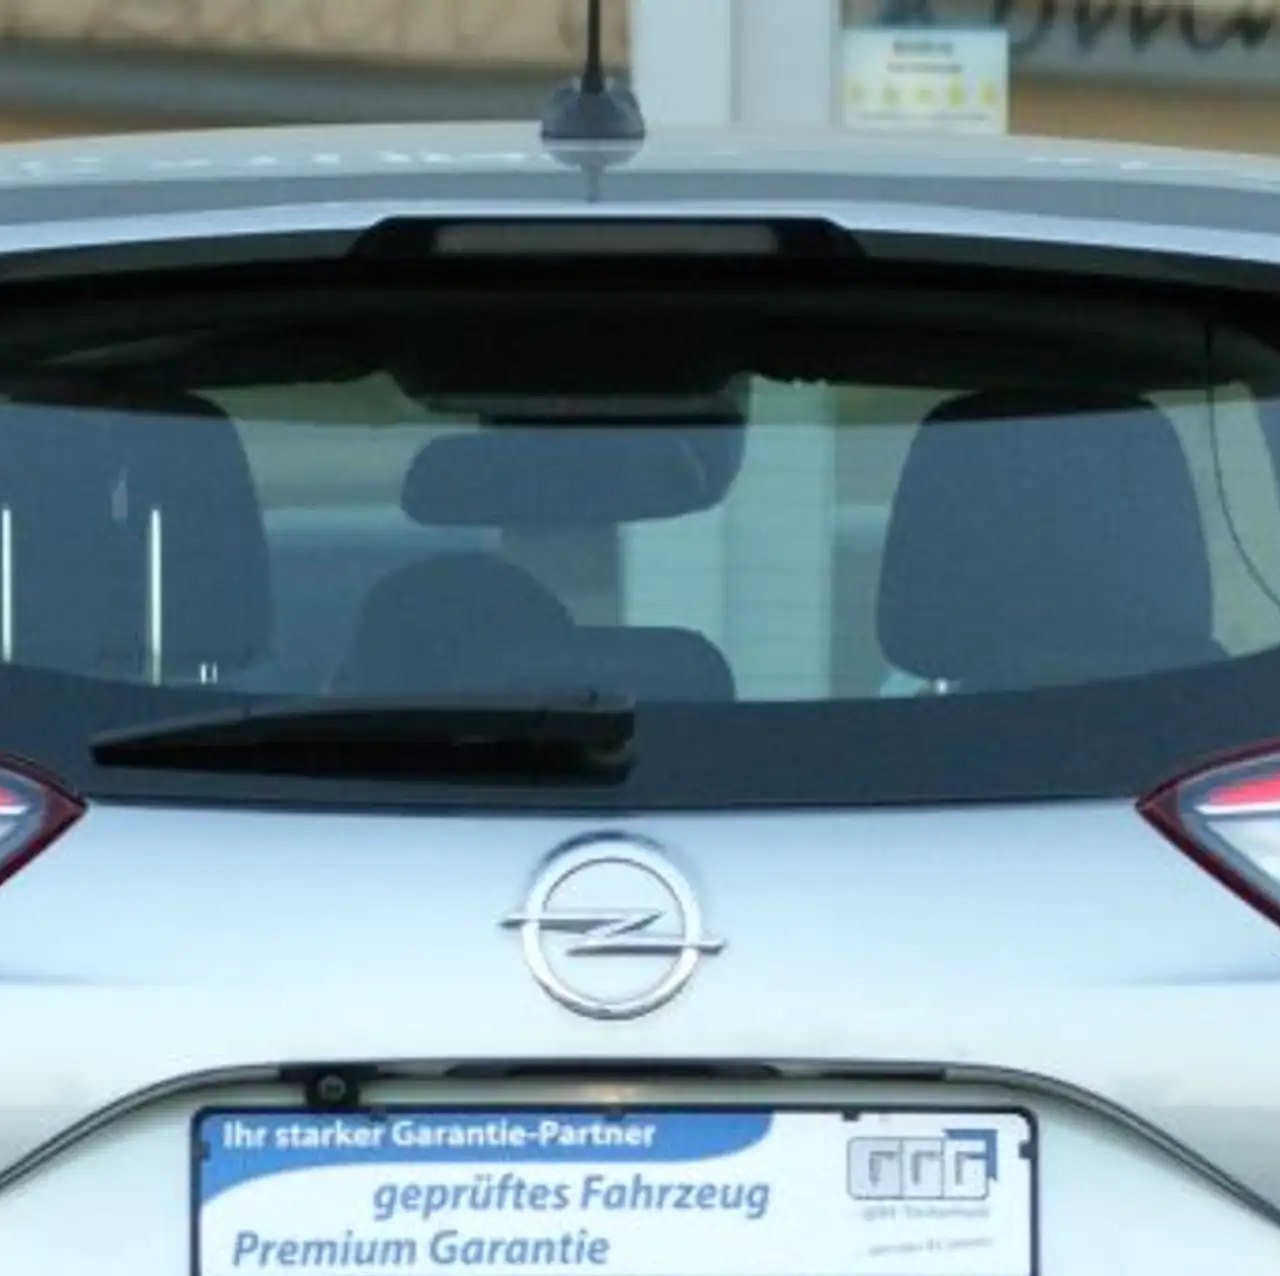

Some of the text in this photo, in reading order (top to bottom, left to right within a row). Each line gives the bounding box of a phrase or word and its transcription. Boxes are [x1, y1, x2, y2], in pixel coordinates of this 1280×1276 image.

[223, 1120, 658, 1150] Ihr starker Garantie-Partner
[371, 1173, 772, 1222] geprüftes Fahrzeug
[232, 1230, 611, 1269] Premium Garantie
